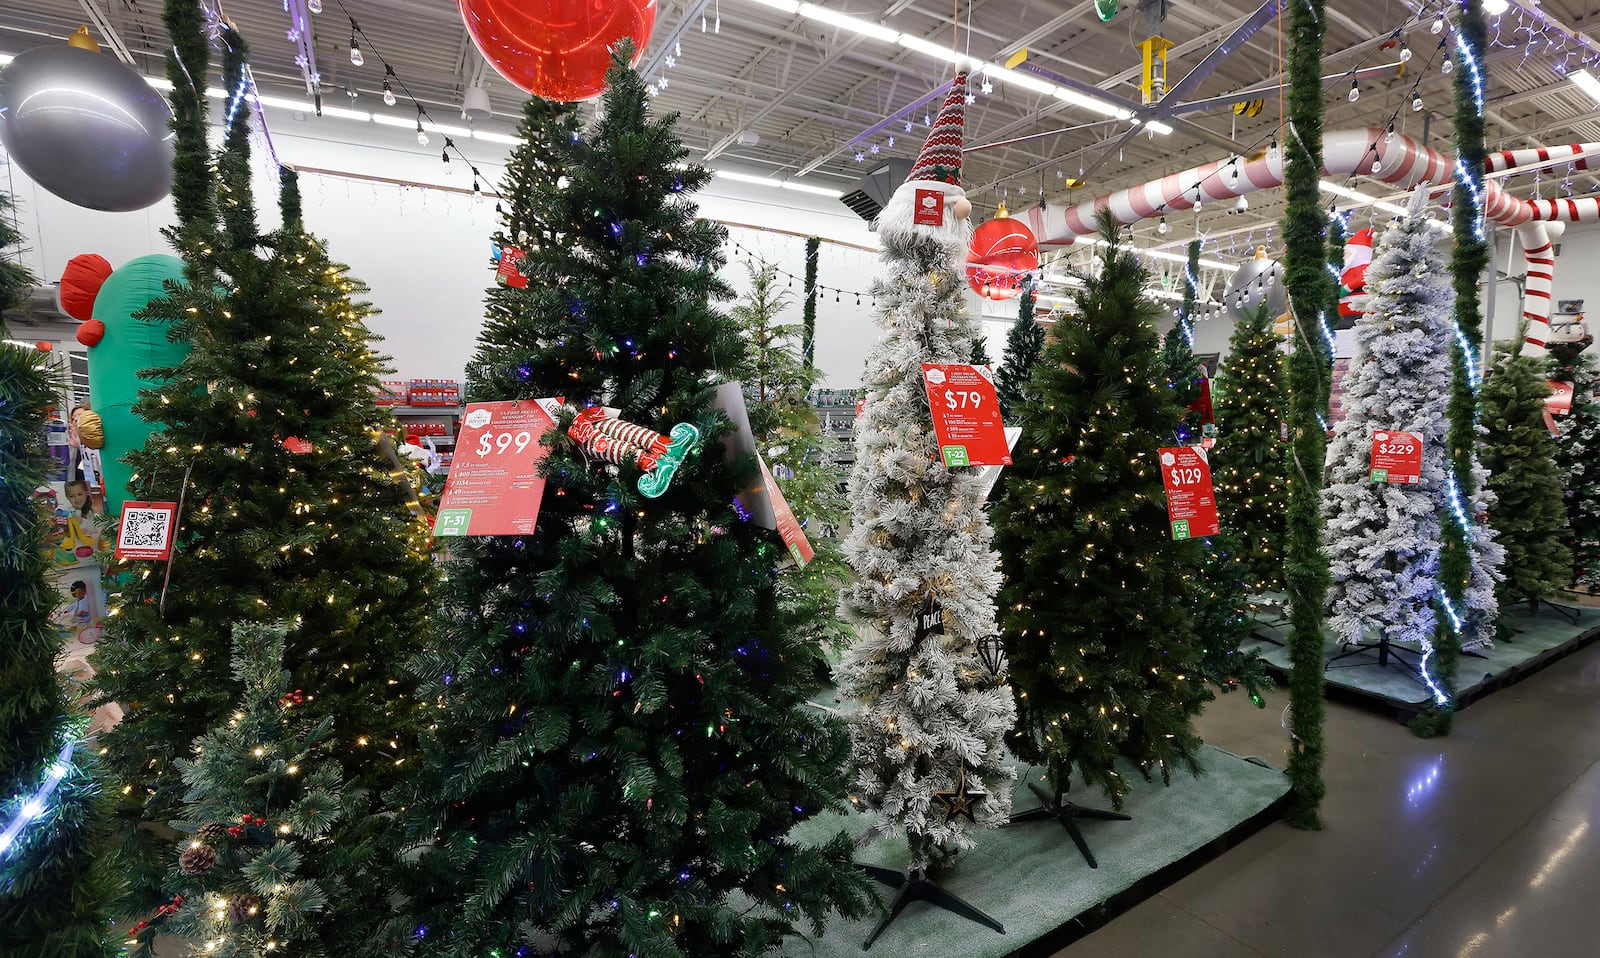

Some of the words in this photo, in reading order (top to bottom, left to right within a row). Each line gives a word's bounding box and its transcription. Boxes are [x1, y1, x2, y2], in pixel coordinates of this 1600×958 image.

[944, 389, 981, 411] $79
[475, 430, 531, 458] $99
[1379, 442, 1415, 455] $229
[946, 450, 965, 459] T-22
[1171, 467, 1202, 487] $129
[443, 515, 466, 526] T-31
[923, 609, 941, 630] PEACE
